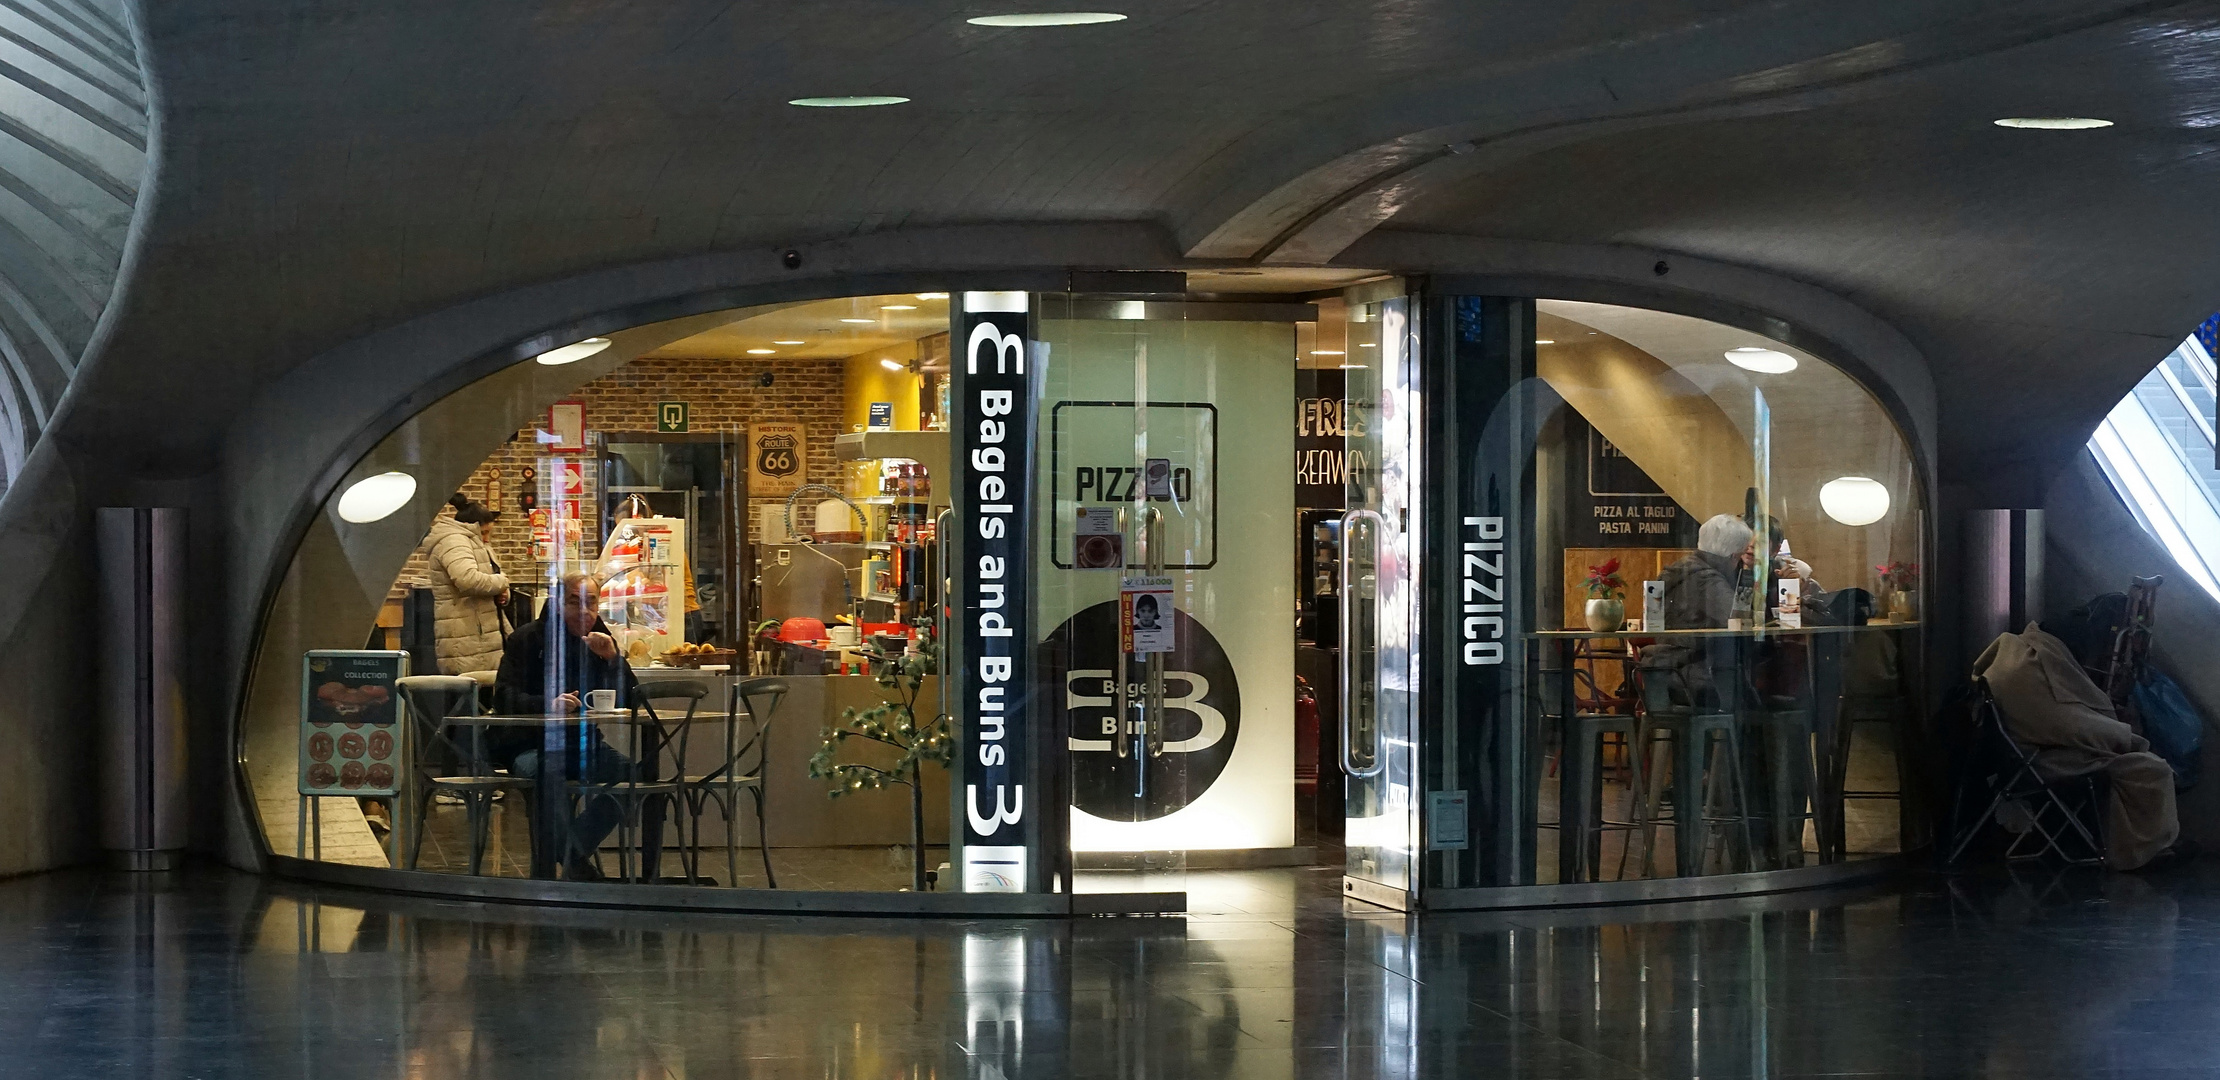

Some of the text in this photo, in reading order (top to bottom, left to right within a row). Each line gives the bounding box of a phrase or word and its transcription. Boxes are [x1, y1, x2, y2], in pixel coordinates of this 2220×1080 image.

[764, 439, 790, 448] ROUTE
[1601, 437, 1628, 458] PI
[764, 451, 790, 470] 66
[971, 390, 1014, 540] Bagels
[1076, 466, 1191, 502] PIZZO
[1594, 505, 1676, 518] PIZZA AL TAGLIO
[1599, 522, 1670, 534] PASTA PANINI
[979, 555, 1013, 637] and
[1463, 516, 1504, 665] PIZZICO
[1121, 593, 1133, 651] MISSING
[1102, 679, 1168, 698] Bgel
[979, 656, 1013, 767] Buns
[1101, 716, 1157, 735] Bn
